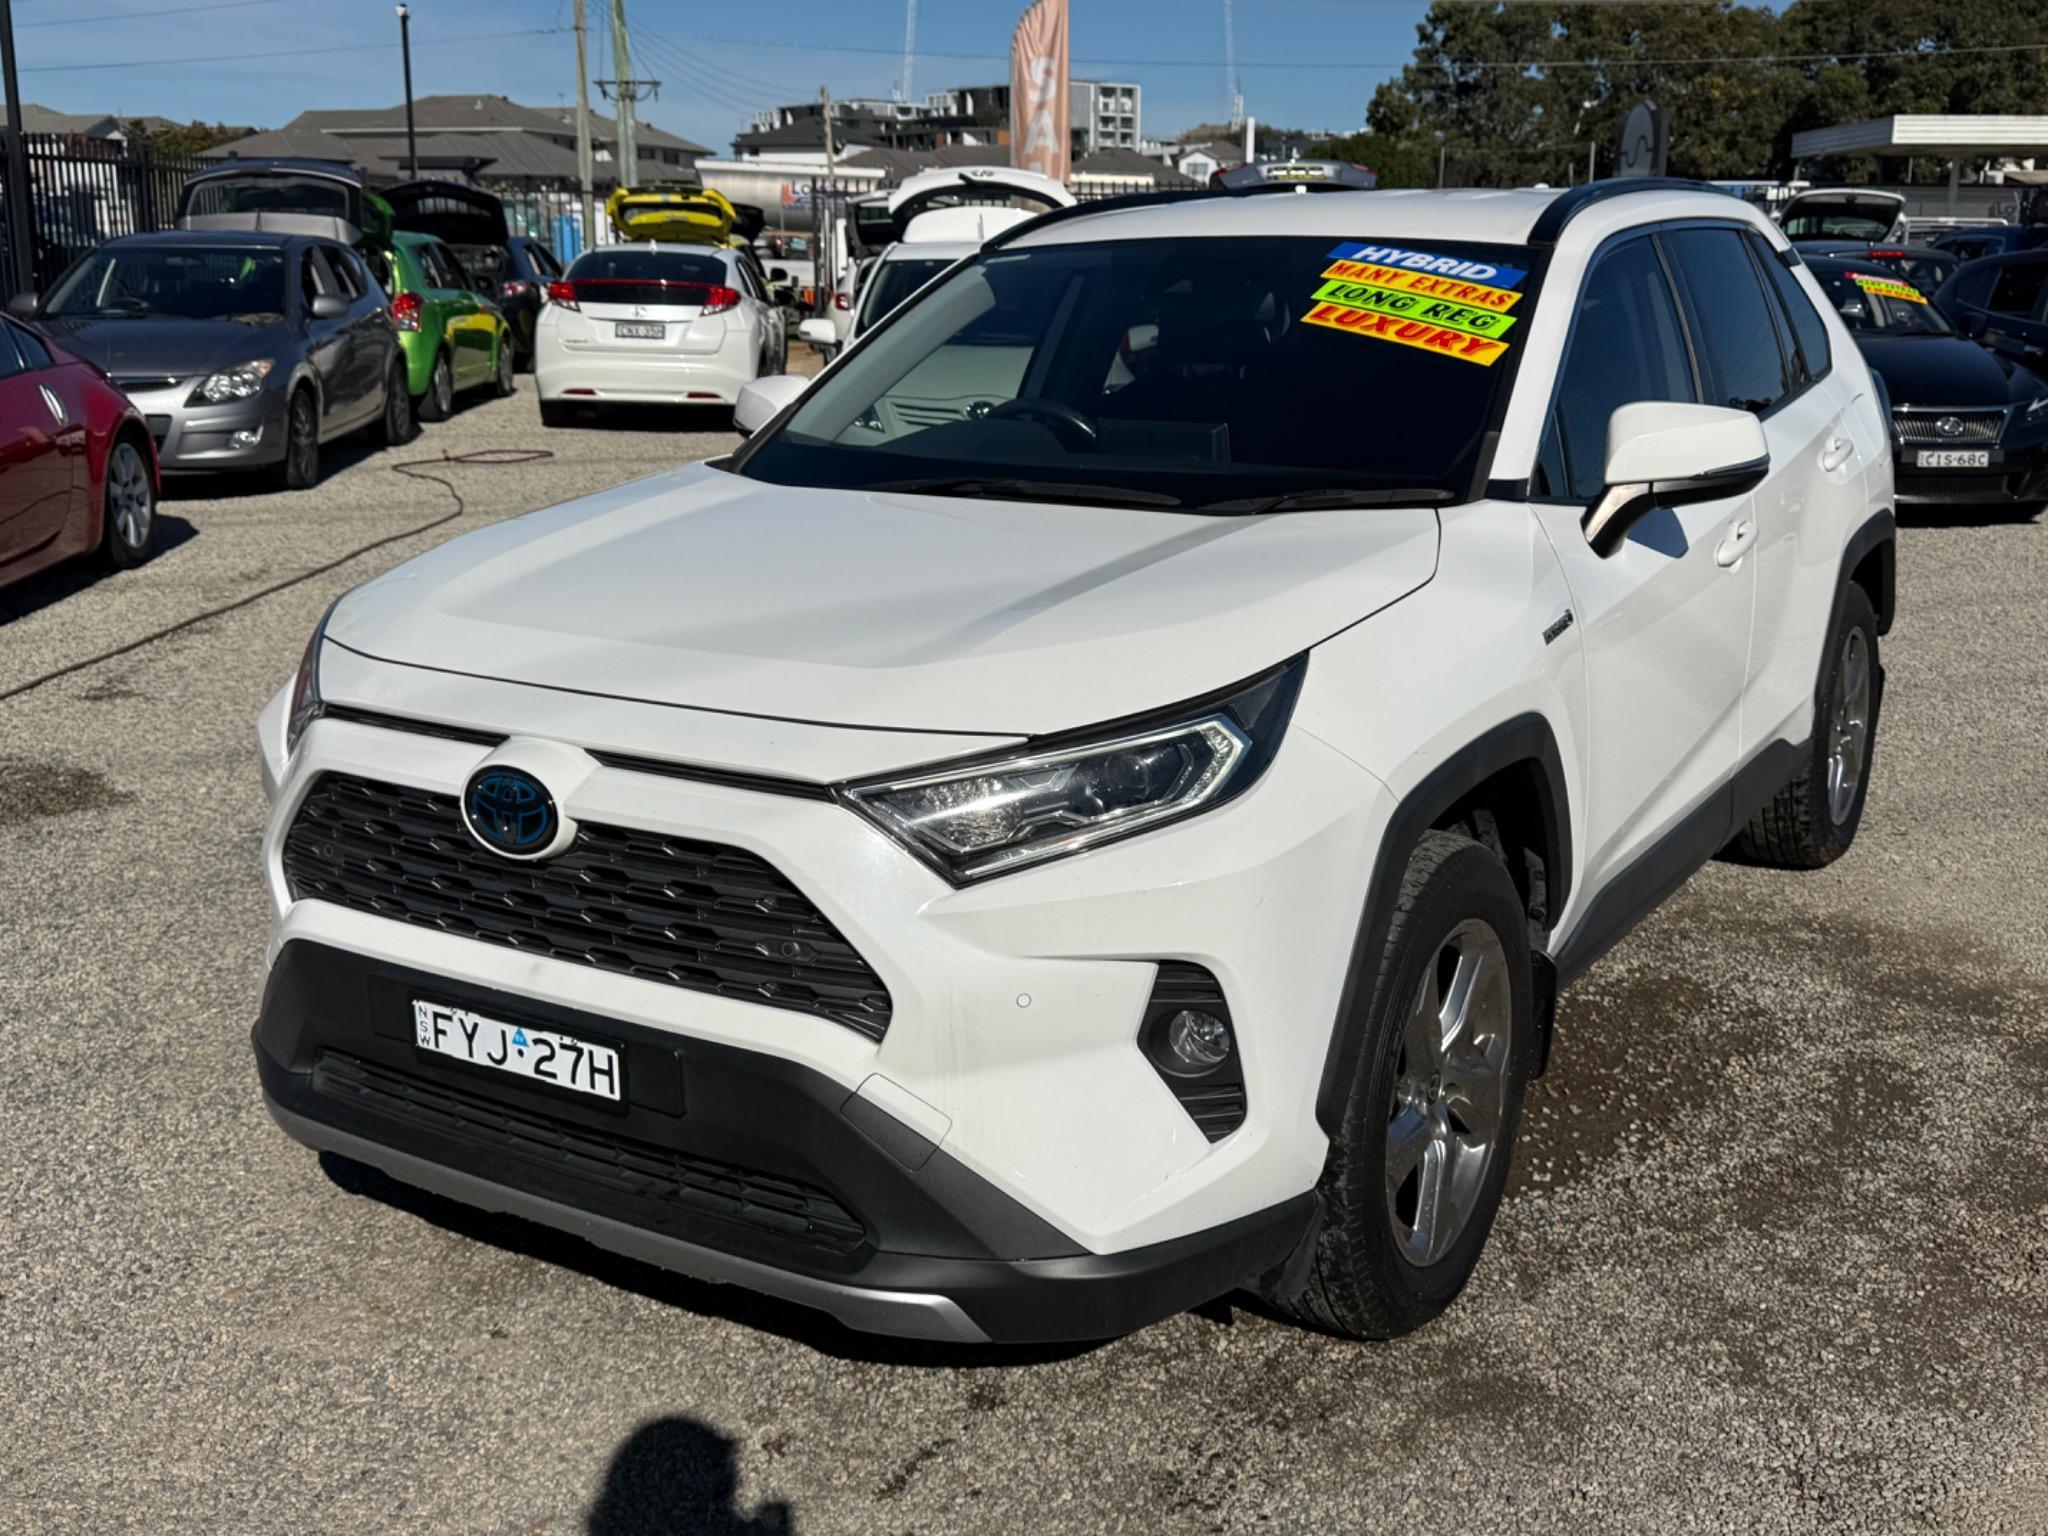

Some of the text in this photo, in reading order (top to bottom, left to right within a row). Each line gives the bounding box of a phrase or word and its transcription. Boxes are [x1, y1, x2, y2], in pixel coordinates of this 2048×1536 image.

[1330, 261, 1513, 307] MANY EXTRAS
[1351, 246, 1498, 280] HYBRID
[1327, 284, 1501, 330] LONG REG
[1310, 305, 1499, 356] LUXURY
[417, 1006, 431, 1047] NSW
